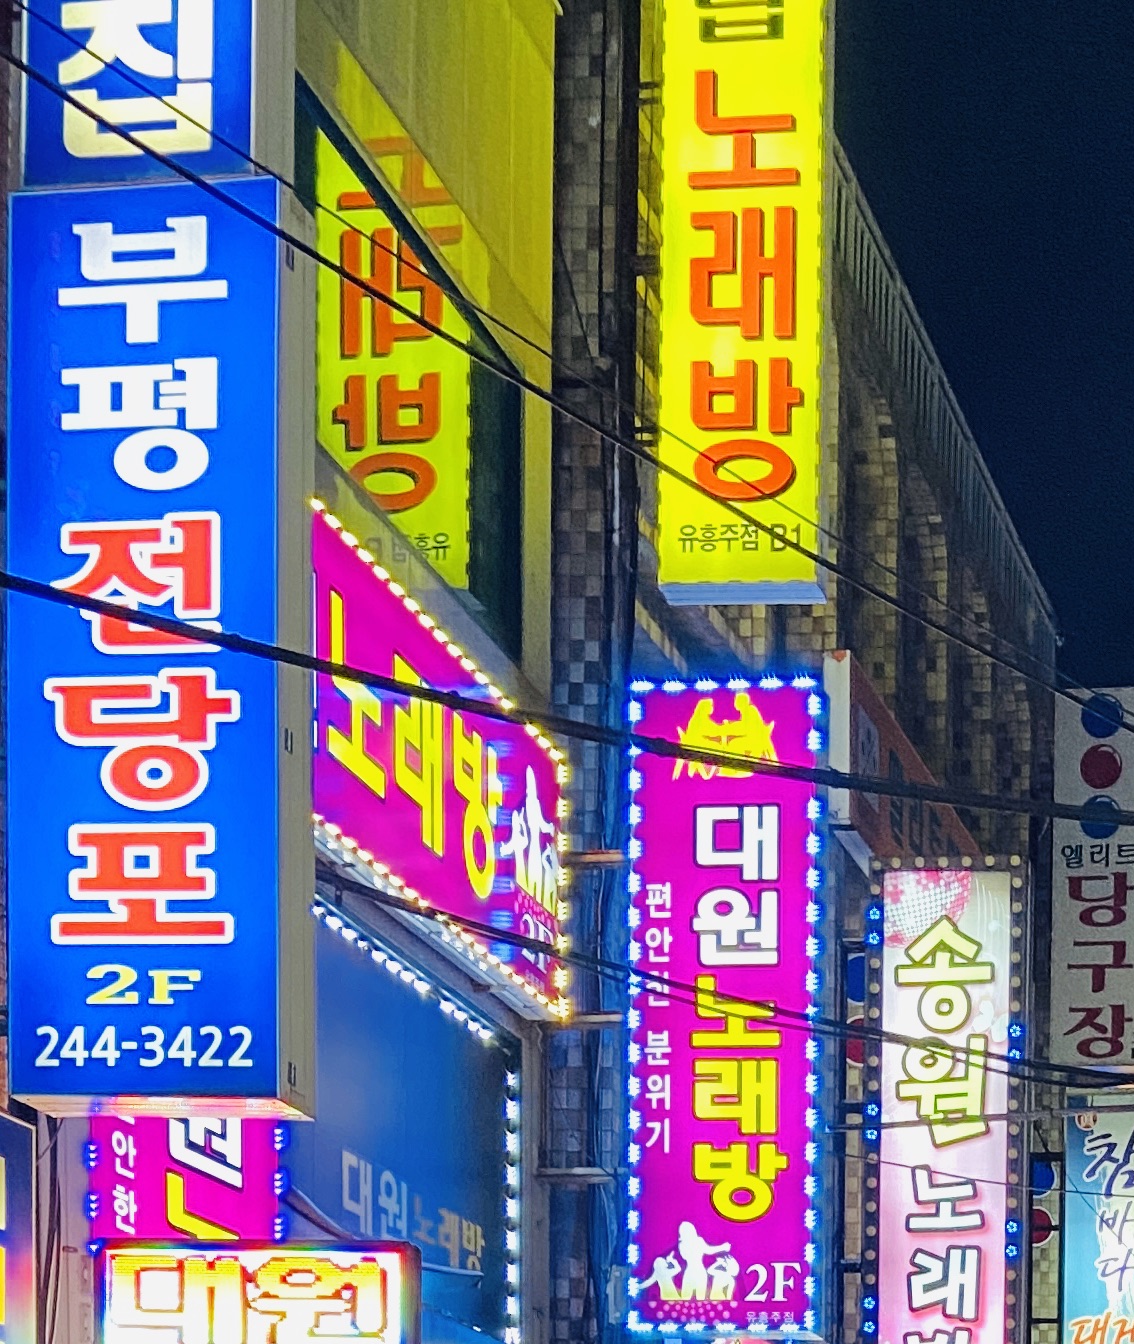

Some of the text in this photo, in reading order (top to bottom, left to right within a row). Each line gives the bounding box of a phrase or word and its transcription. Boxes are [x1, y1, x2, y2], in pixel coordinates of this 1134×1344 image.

[688, 69, 805, 503] 노래방
[327, 588, 504, 899] 노래방
[85, 964, 202, 1006] 2F
[33, 1024, 254, 1069] 244-3422
[644, 1029, 672, 1154] 분위기
[744, 1260, 802, 1303] 2F
